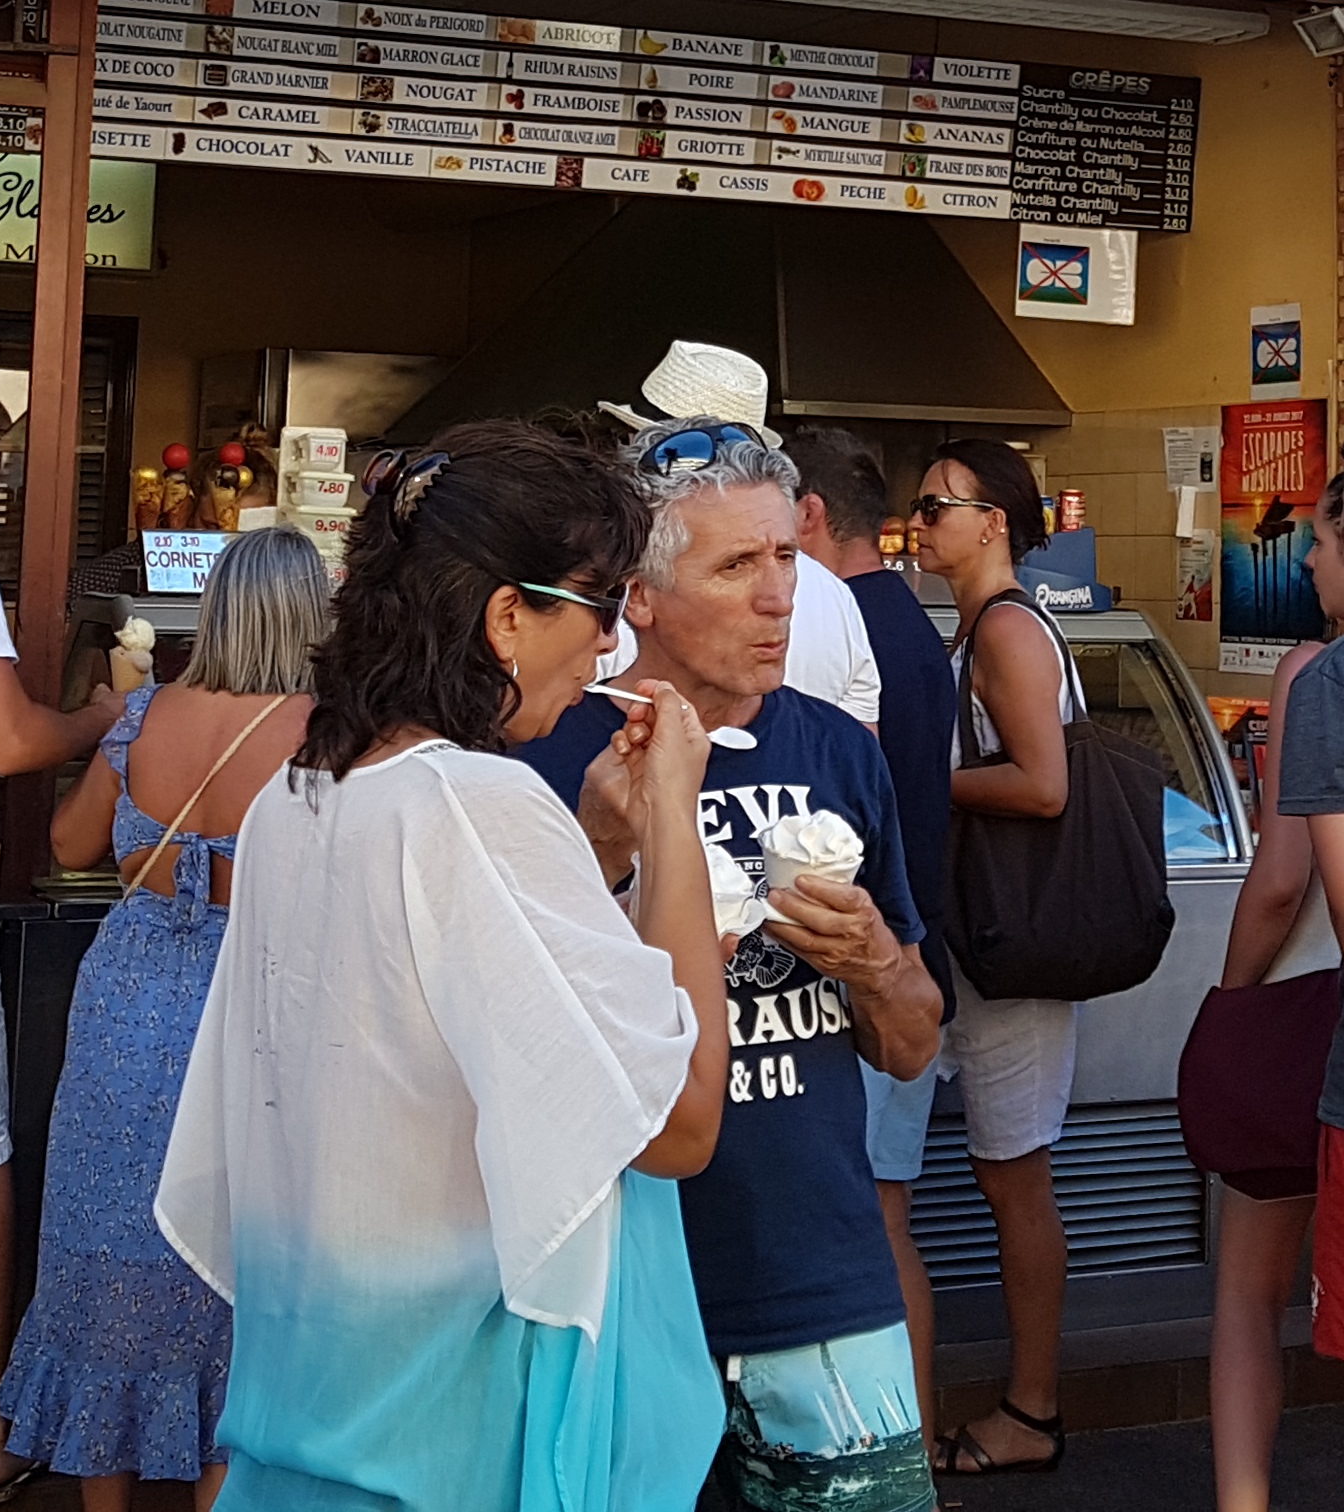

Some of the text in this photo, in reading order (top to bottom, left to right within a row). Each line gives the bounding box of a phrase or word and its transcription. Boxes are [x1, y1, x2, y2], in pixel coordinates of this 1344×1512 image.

[252, 0, 322, 19] MELON
[383, 11, 484, 34] NOIX du PERIGORD
[127, 24, 183, 43] NOUGATINE
[542, 26, 617, 46] ABRICOT
[237, 35, 338, 57] NOUGAT BLANC MIEL
[671, 38, 744, 57] BANANE
[382, 47, 481, 68] MARRON GLACE
[790, 48, 875, 69] MENTHE CHOCOLAT
[111, 60, 174, 77] DE COCO
[524, 60, 617, 80] RHUM RAISINS
[943, 62, 1012, 81] VIOLETTE
[231, 70, 329, 90] GRAND MARNIER
[688, 73, 734, 89] POIRE
[1069, 70, 1152, 92] CRÊPES
[406, 84, 477, 102] NOUGAT
[798, 84, 878, 104] MANDARINE
[1022, 85, 1065, 100] Sucre
[115, 95, 172, 113] de Yaourt
[532, 94, 620, 113] FRAMBOISE
[941, 96, 1016, 114] PAMPLEMOUSSE
[1021, 100, 1157, 122] Chantilly ou Chocolat
[237, 105, 320, 125] CARAMEL
[674, 106, 742, 123] PASSION
[386, 117, 479, 137] STRACCIATELLA
[801, 116, 871, 134] MANGUE
[1019, 116, 1165, 138] Crème de Marron ou Alcool
[564, 130, 593, 145] ORANGE
[933, 128, 1004, 146] ANANAS
[1017, 131, 1144, 152] Confiture ou Nutella
[195, 137, 292, 158] CHOCOLAT
[677, 139, 745, 156] GRIOTTE
[345, 149, 414, 166] VANILLE
[468, 157, 546, 175] PISTACHE
[804, 148, 883, 167] MYRTILLE SAUVAGE
[1015, 146, 1139, 170] Chocolat Chantilly
[611, 167, 650, 182] CAFE
[929, 161, 1008, 178] FRAISE DES BOIS
[1014, 161, 1122, 184] Marron Chantilly
[719, 175, 769, 191] CASSIS
[840, 184, 886, 200] PECHE
[1012, 177, 1140, 200] Confiture Chantilly
[942, 193, 998, 208] CITRON
[1011, 193, 1119, 214] Nutella Chantilly
[1010, 208, 1102, 225] Citron ou Miel
[4, 242, 118, 267] Mon
[316, 444, 338, 458] 4.10
[1242, 430, 1304, 472] ESCAPADES
[1242, 451, 1304, 493] MUSICALES
[317, 480, 345, 494] 7.80
[315, 519, 346, 532] 9.90
[729, 1054, 805, 1103] & CO.
